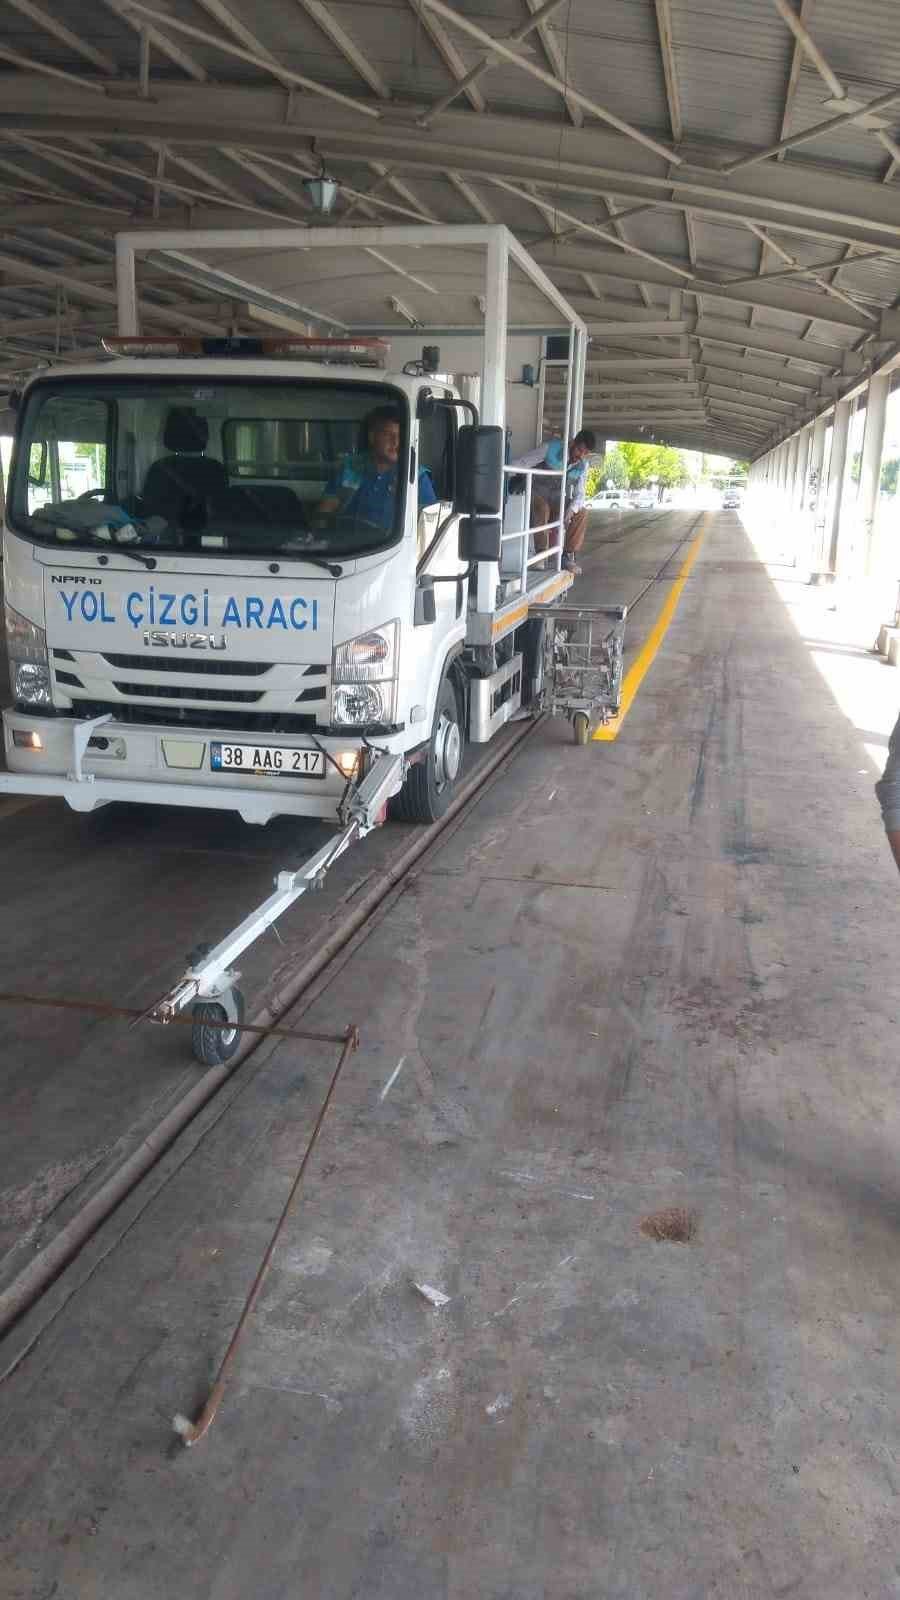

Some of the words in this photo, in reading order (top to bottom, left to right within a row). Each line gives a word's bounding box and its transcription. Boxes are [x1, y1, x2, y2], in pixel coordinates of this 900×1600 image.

[59, 591, 116, 622] YOL
[126, 585, 208, 629] ÇİZGİ
[221, 596, 318, 631] ARACI
[143, 630, 228, 650] ISUZU
[223, 747, 243, 766] 38
[252, 749, 283, 769] AAG
[292, 752, 320, 771] 217
